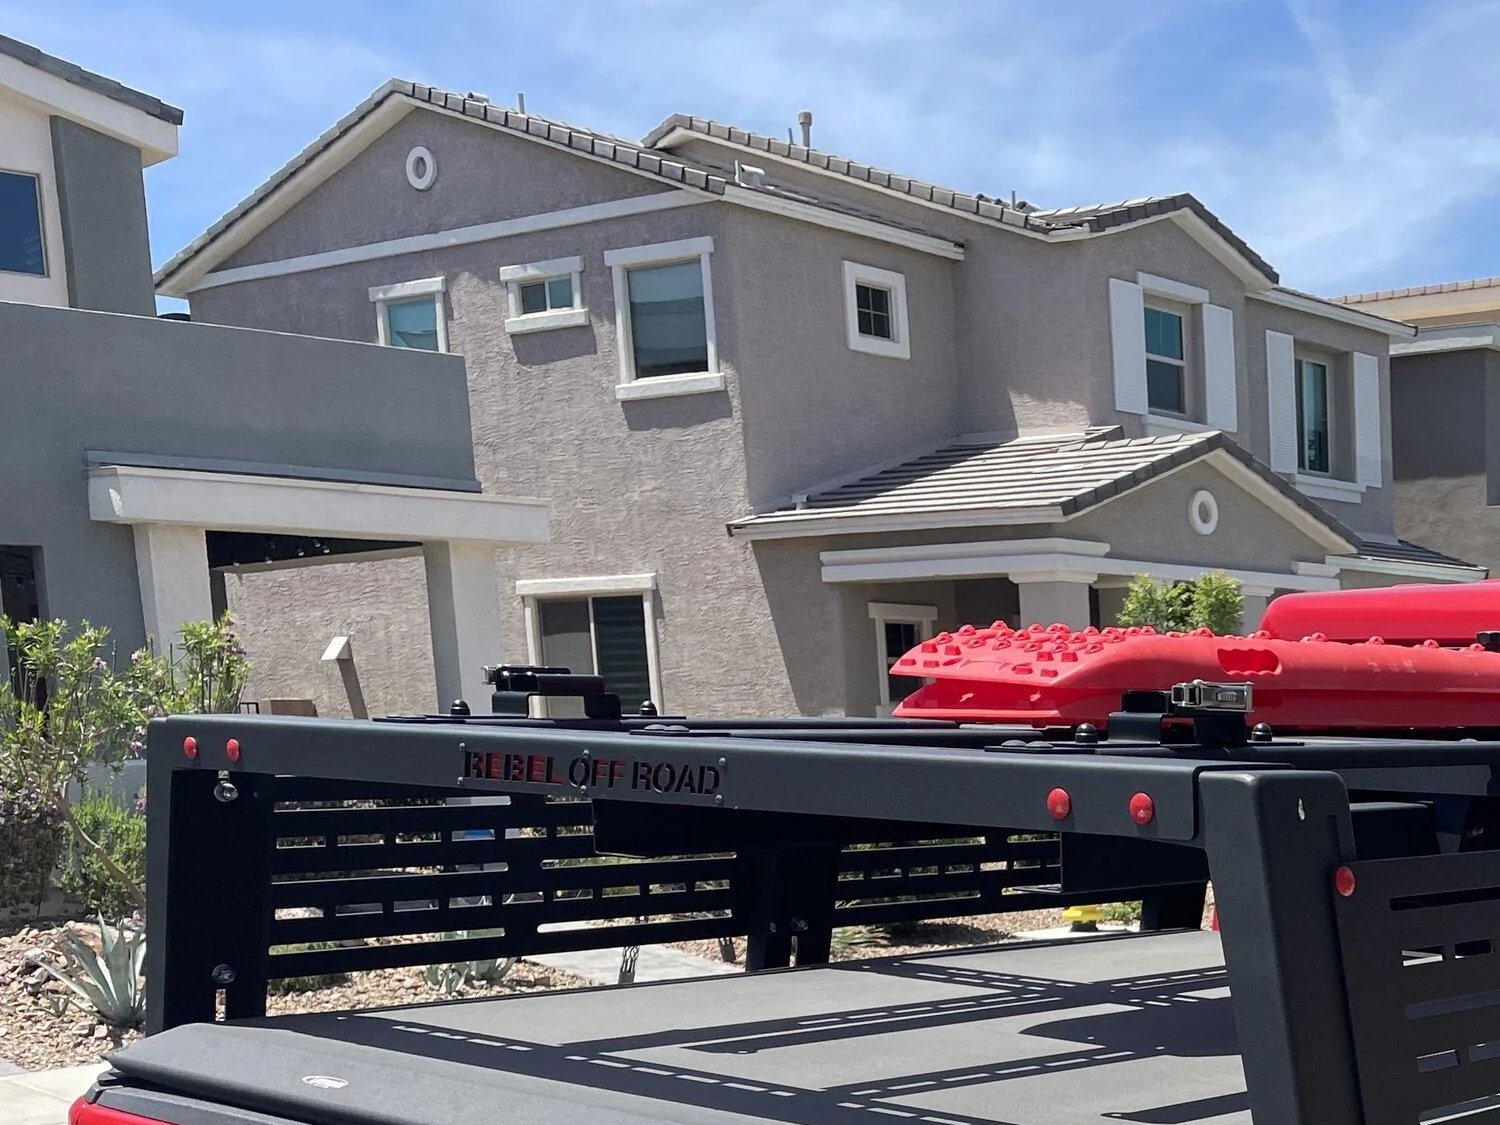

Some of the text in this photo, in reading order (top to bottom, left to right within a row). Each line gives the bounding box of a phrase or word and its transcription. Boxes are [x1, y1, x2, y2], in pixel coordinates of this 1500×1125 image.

[464, 750, 721, 796] REBEL OFF ROAD
